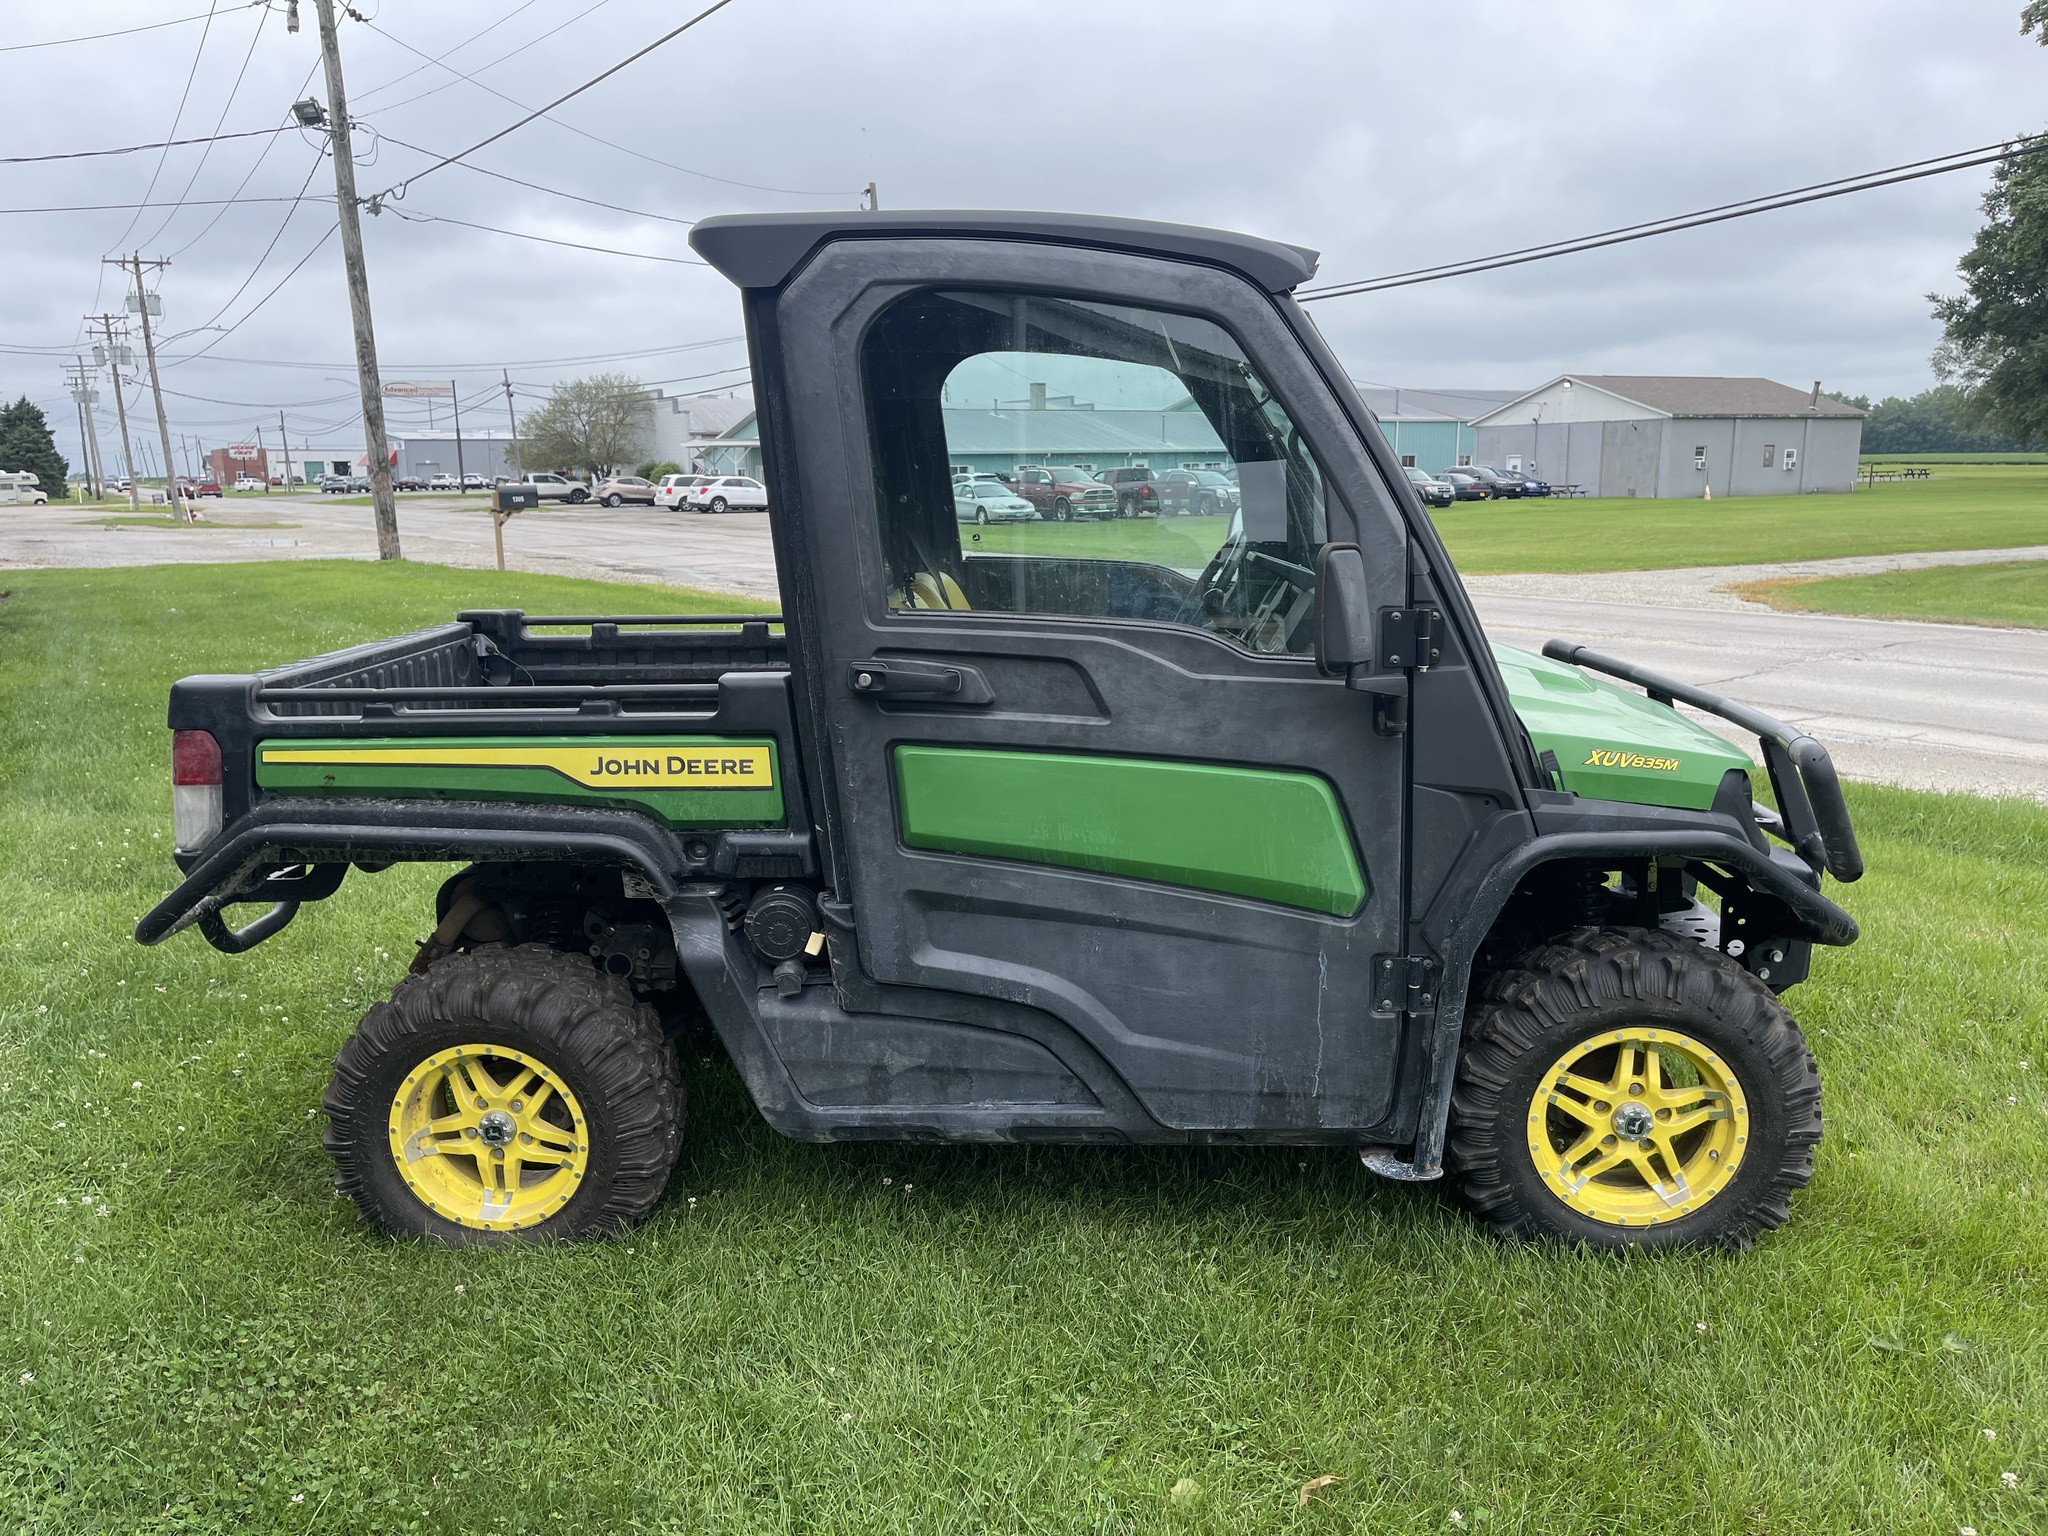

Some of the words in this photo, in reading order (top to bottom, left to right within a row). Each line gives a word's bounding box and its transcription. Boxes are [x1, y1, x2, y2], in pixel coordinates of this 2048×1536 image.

[590, 756, 660, 775] JOHN
[667, 756, 754, 775] DEERE
[1584, 749, 1680, 772] XUV835M
